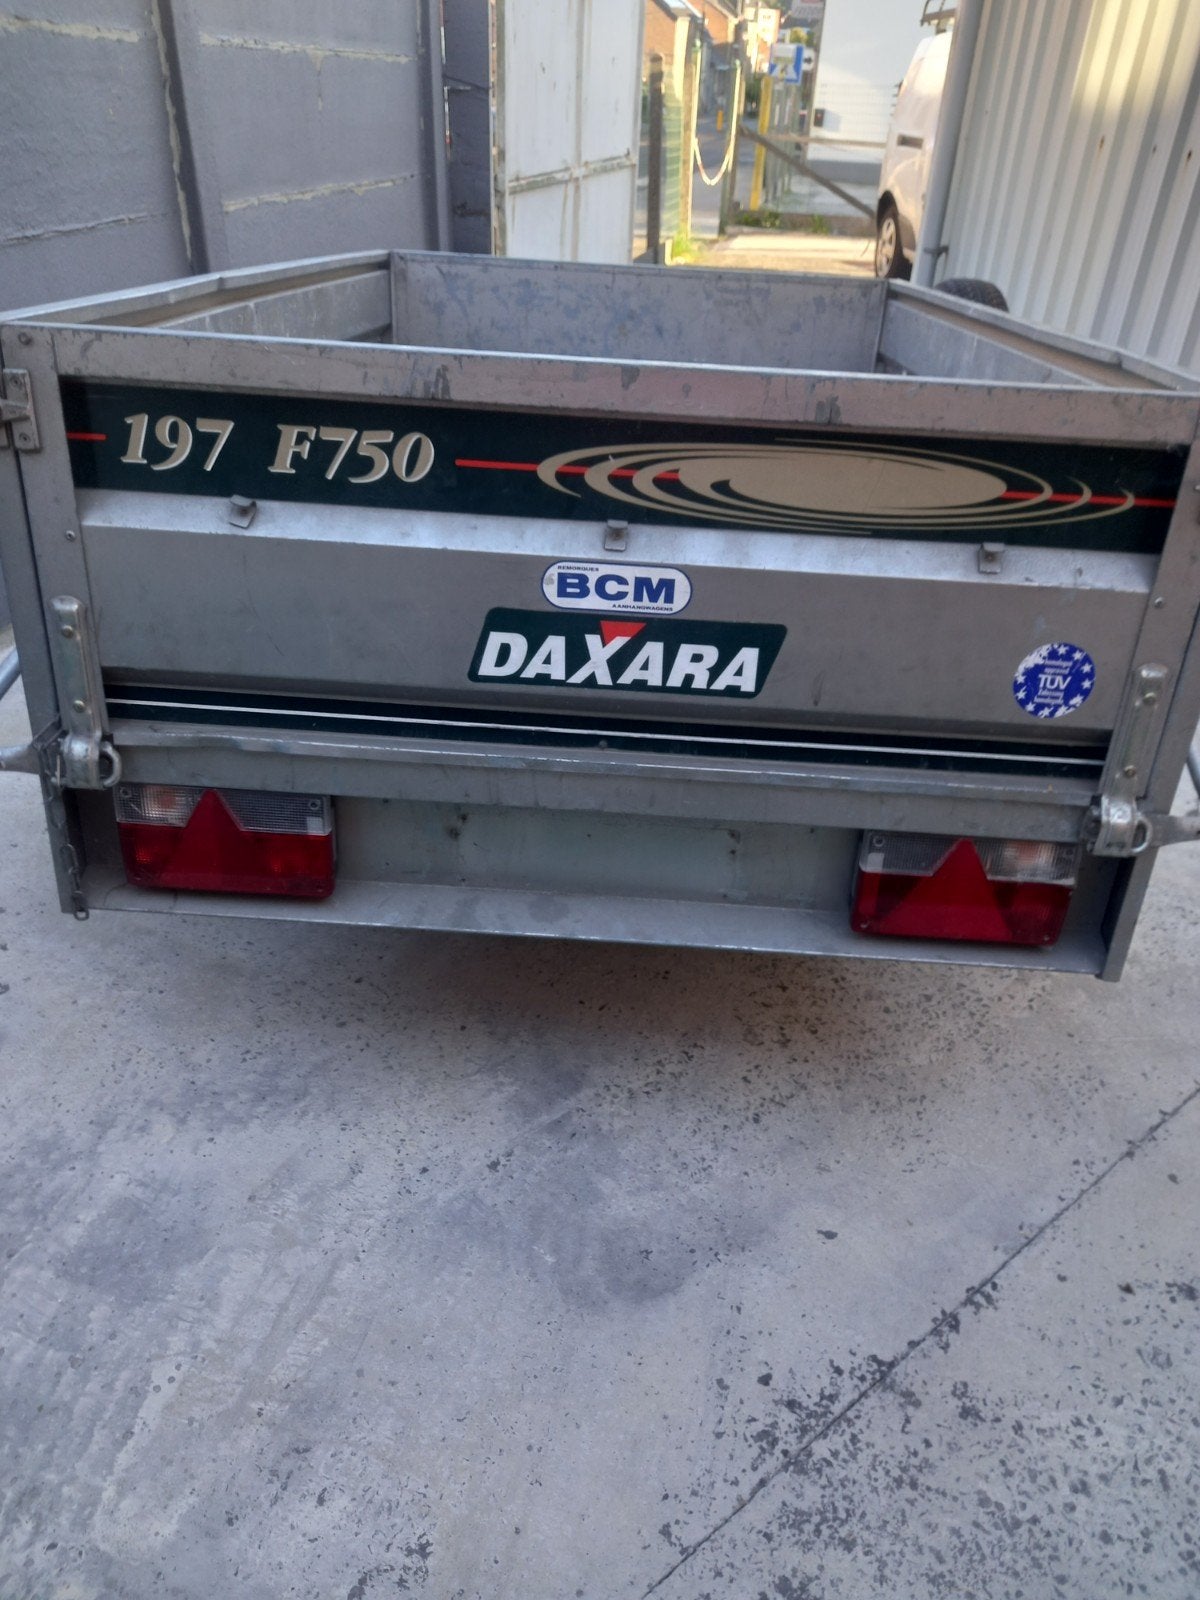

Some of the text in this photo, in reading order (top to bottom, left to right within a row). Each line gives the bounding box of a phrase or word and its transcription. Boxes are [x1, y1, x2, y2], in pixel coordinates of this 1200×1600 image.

[120, 413, 435, 483] 197 F750
[556, 572, 676, 604] BCM
[477, 631, 761, 692] DAXARA
